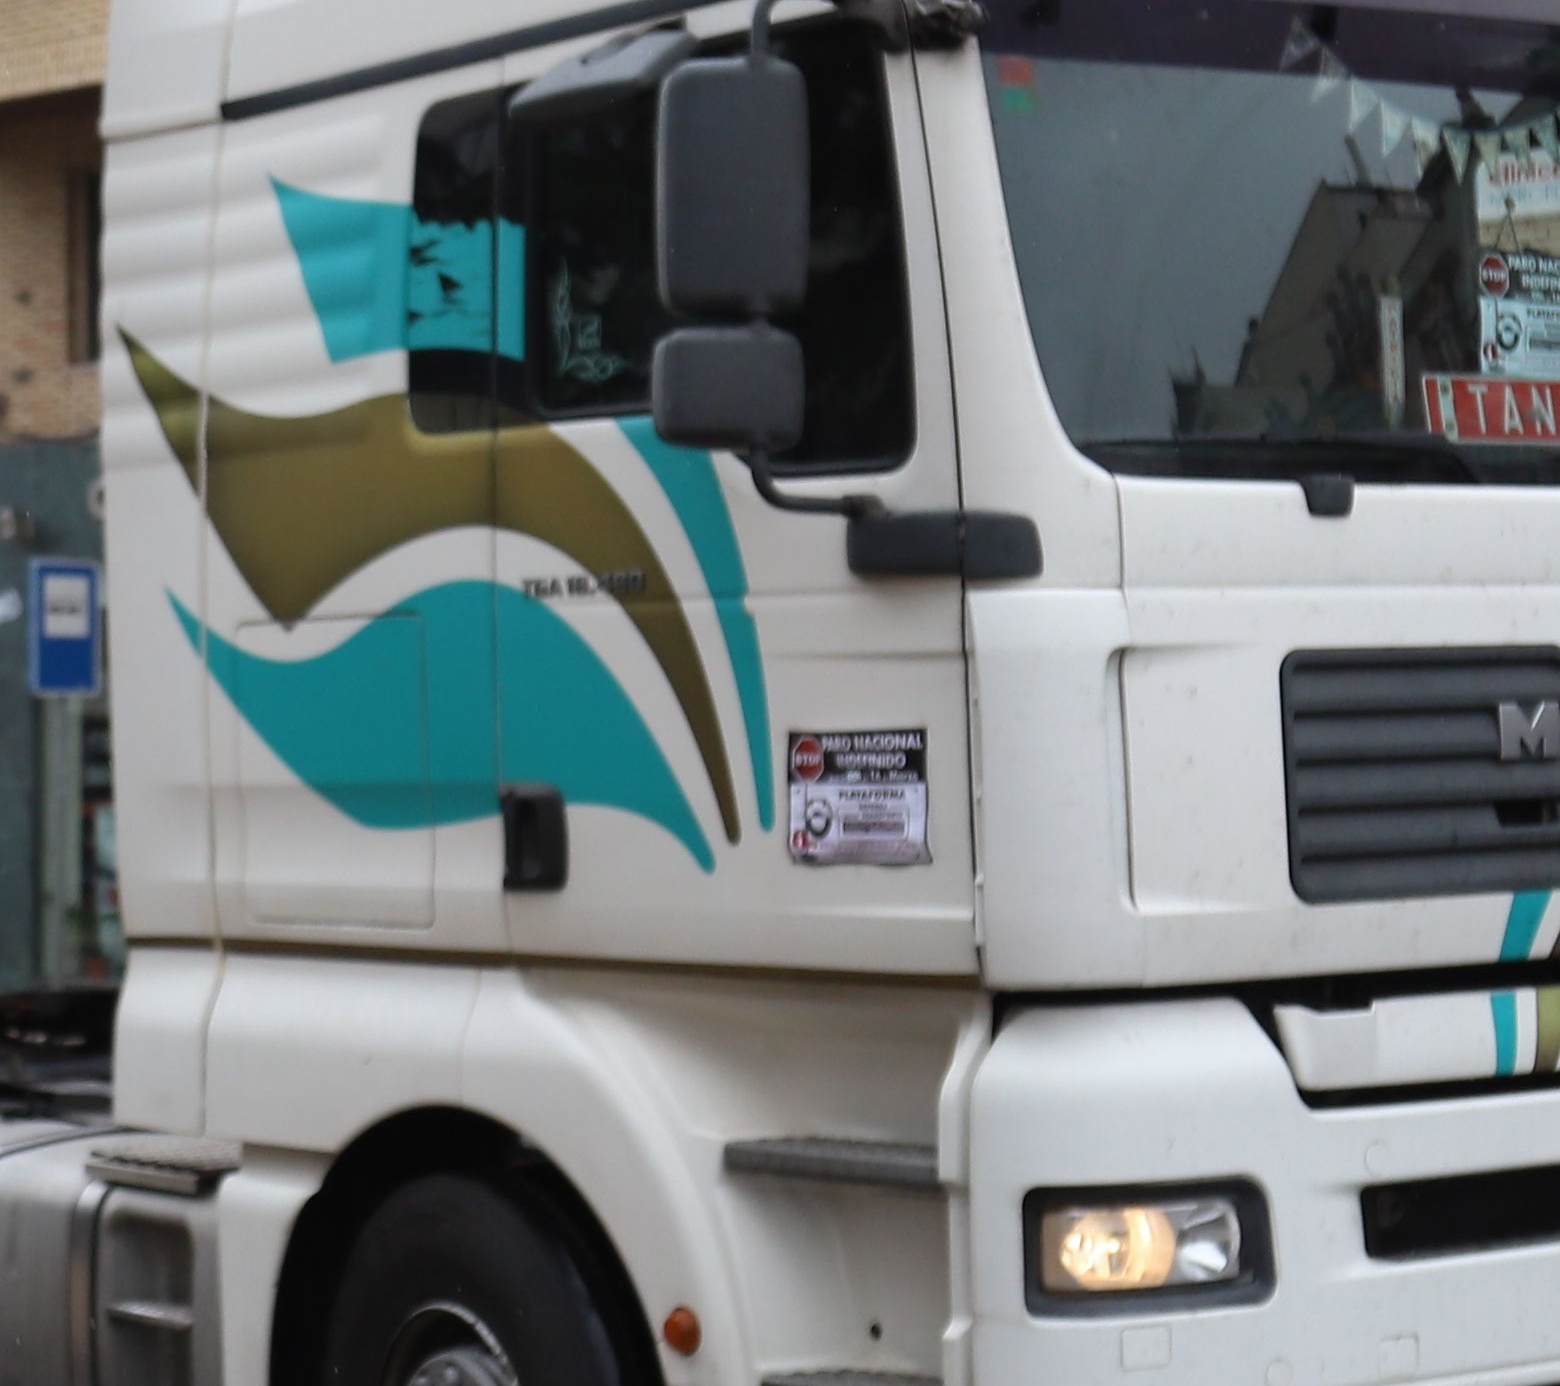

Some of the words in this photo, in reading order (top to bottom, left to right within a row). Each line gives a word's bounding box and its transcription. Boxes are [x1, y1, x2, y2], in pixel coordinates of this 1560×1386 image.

[1508, 254, 1536, 272] PARO
[1482, 268, 1506, 282] STOP
[822, 735, 852, 752] PARO
[854, 733, 923, 750] NACIONAL
[795, 754, 821, 764] STOP
[836, 751, 907, 768] INDEFINIDO
[838, 789, 906, 800] PLATAFORMA
